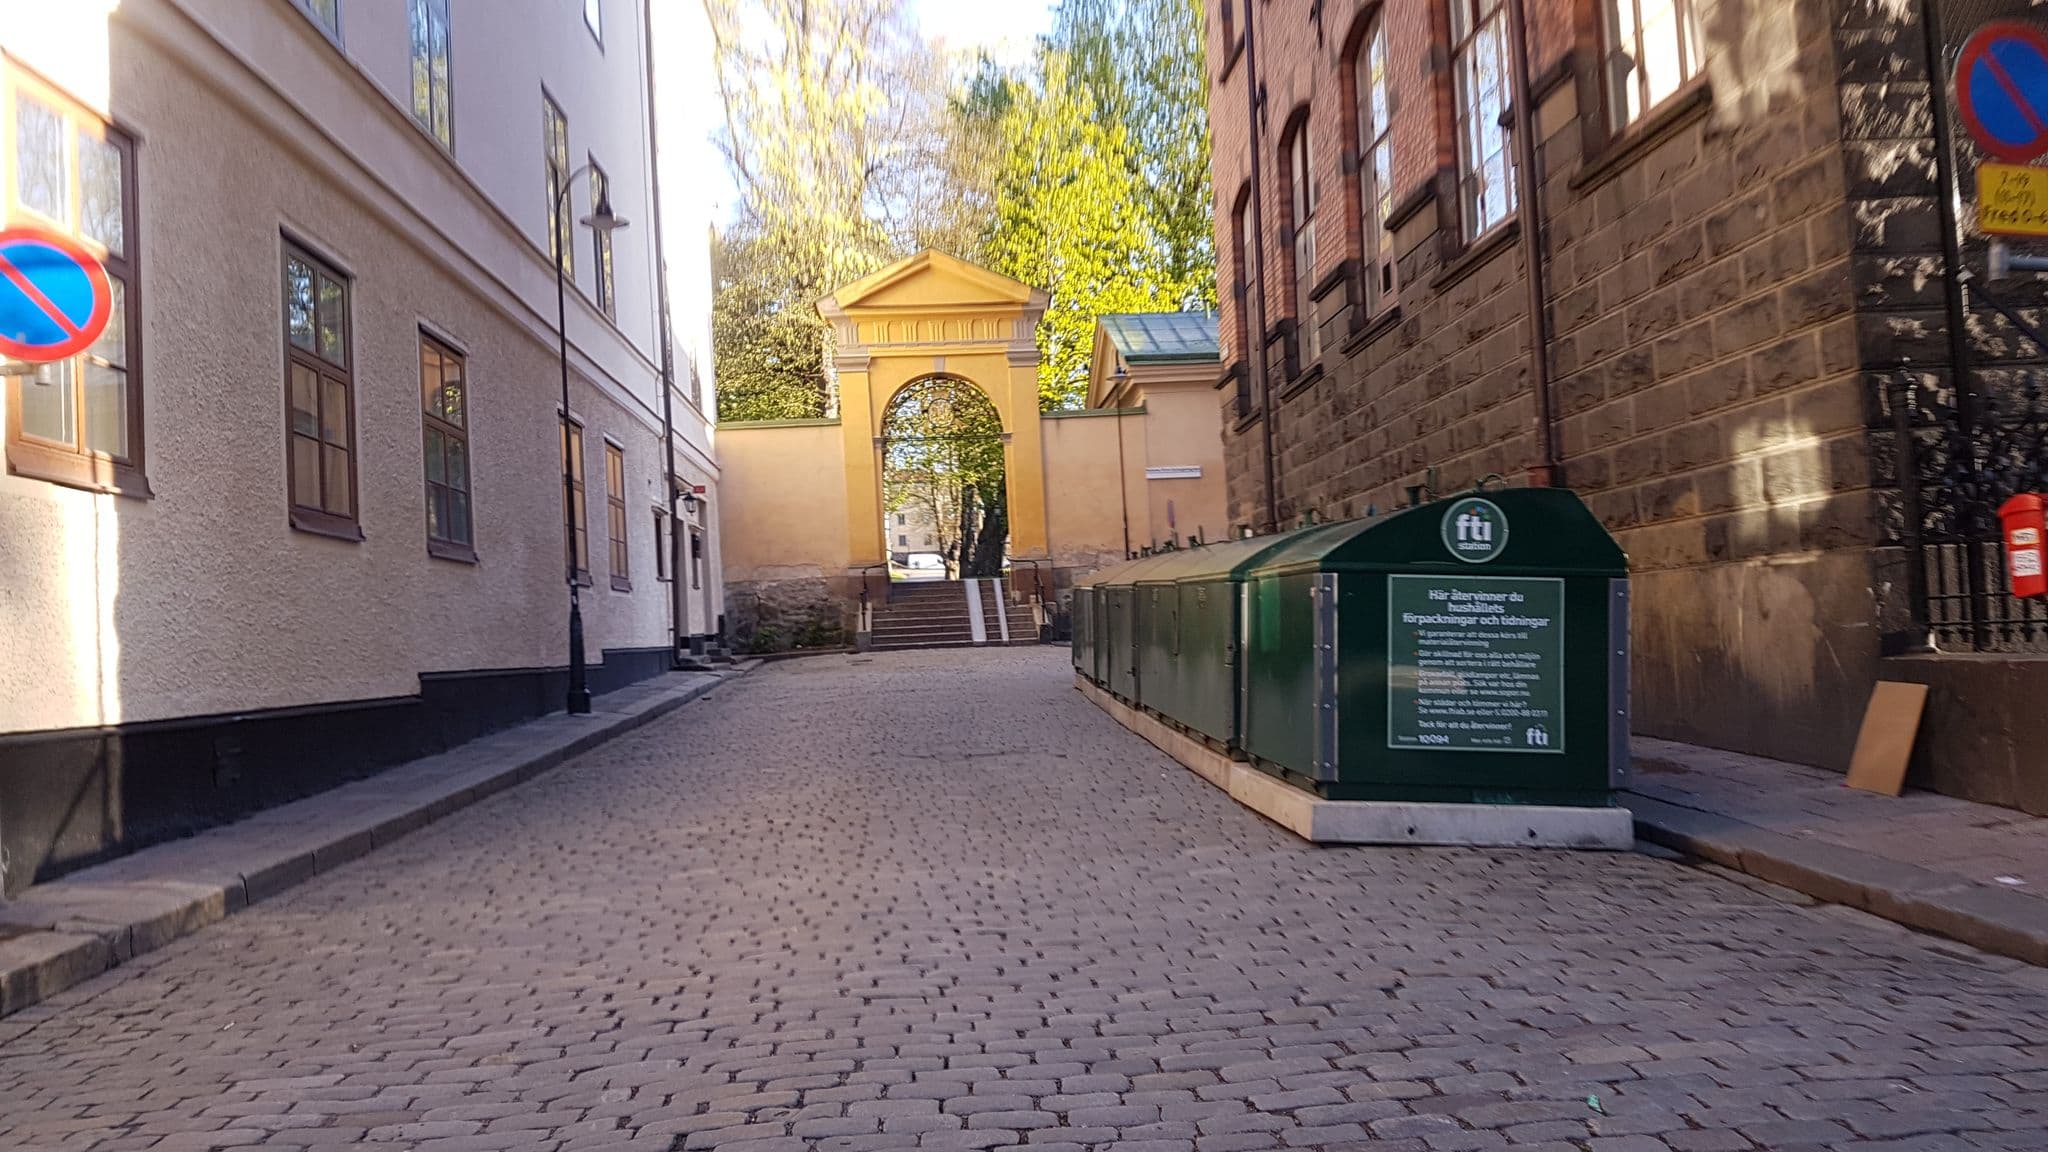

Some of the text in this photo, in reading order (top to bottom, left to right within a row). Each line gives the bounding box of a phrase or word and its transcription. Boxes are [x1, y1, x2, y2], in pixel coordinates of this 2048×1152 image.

[1456, 513, 1491, 541] fti
[1457, 542, 1492, 551] station
[1428, 588, 1524, 602] Här återvinner du
[1447, 601, 1505, 614] hushållets
[1402, 612, 1551, 629] förpackningar och tidningar
[1525, 727, 1549, 746] fti
